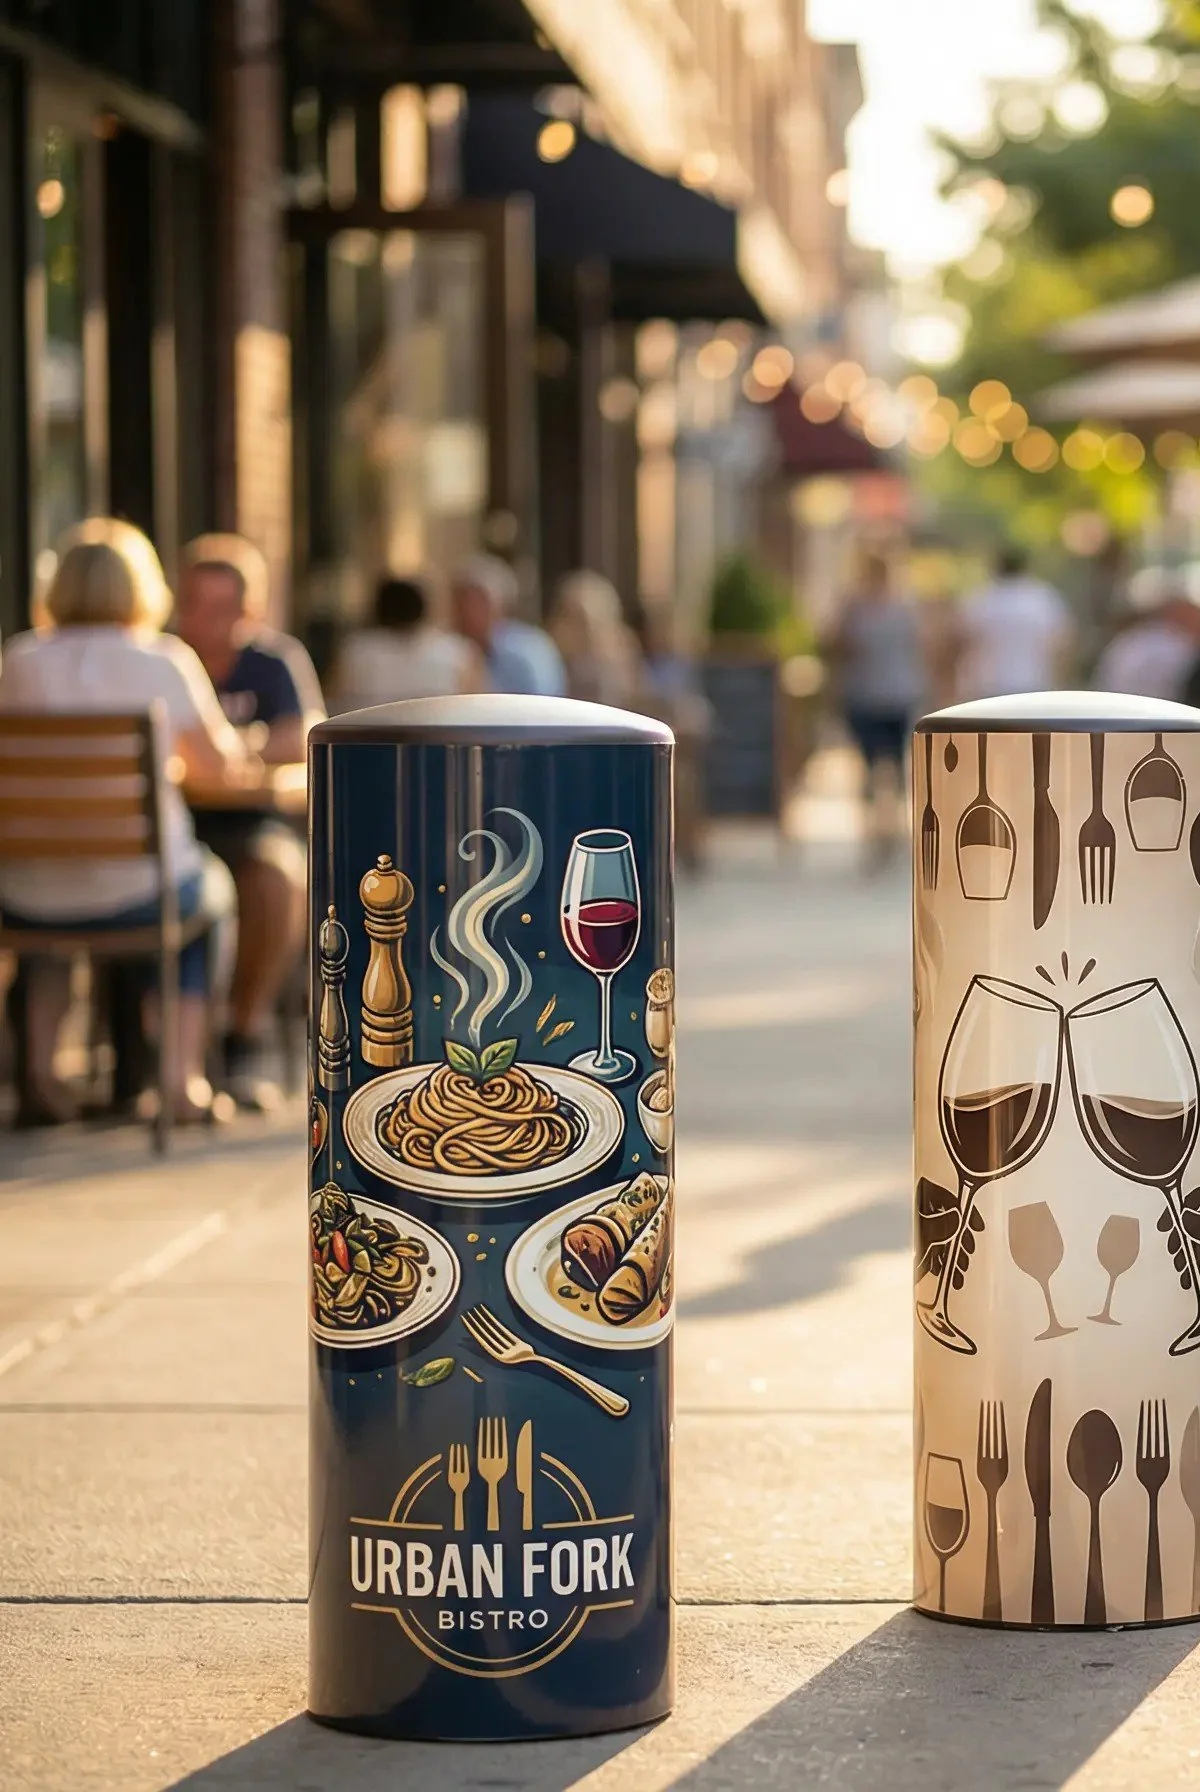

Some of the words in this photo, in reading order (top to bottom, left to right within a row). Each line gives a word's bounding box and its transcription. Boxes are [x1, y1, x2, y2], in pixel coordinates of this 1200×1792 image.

[351, 1535, 504, 1599] URBAN
[523, 1533, 635, 1598] FORK
[438, 1609, 549, 1630] BISTRO
